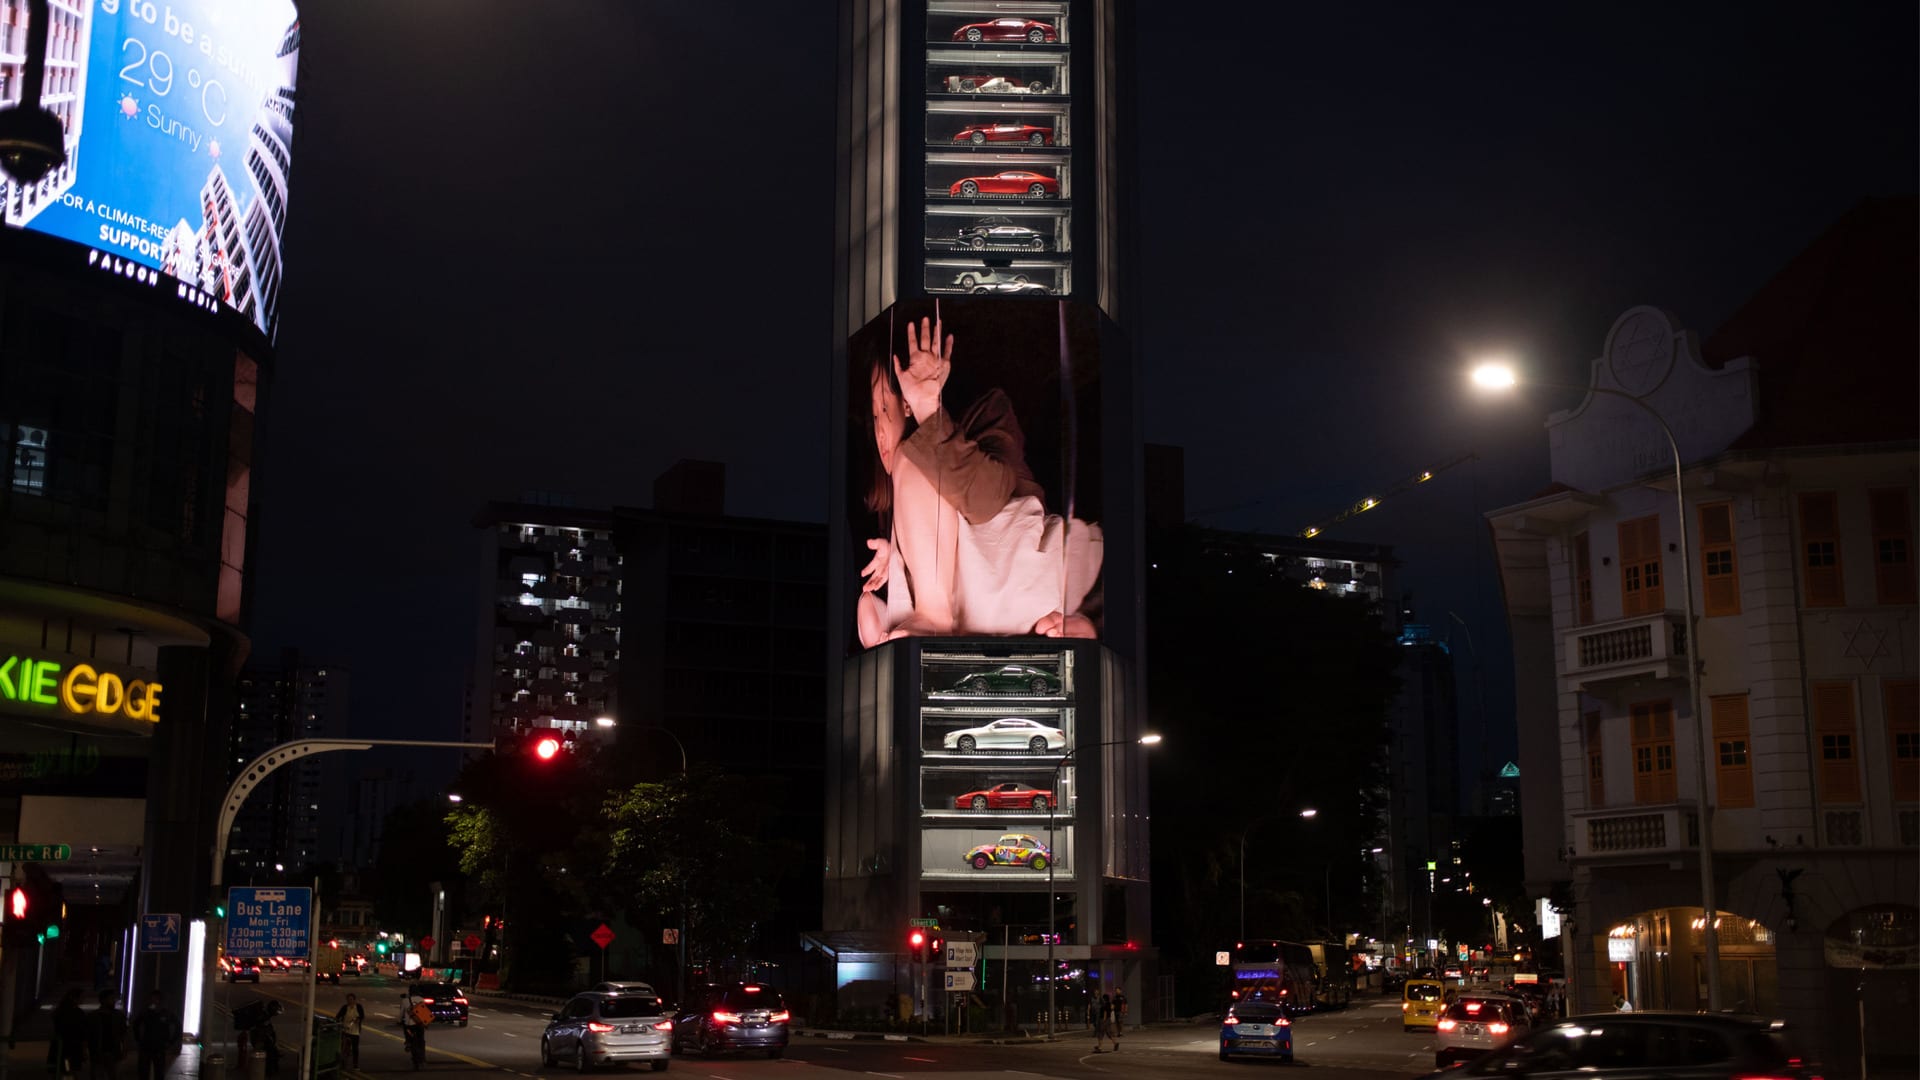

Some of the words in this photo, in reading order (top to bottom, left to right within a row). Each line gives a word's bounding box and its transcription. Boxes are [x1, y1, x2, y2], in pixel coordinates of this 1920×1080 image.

[164, 6, 194, 44] be
[201, 34, 213, 57] a
[119, 38, 173, 96] 29
[147, 104, 202, 152] Sunny
[56, 193, 83, 210] FOR
[86, 201, 95, 214] A
[89, 249, 158, 286] FALCON
[177, 283, 218, 313] MEDIA
[62, 664, 163, 722] EDGE
[43, 847, 62, 860] Rd
[237, 902, 262, 915] Bus
[269, 902, 302, 915] Lane
